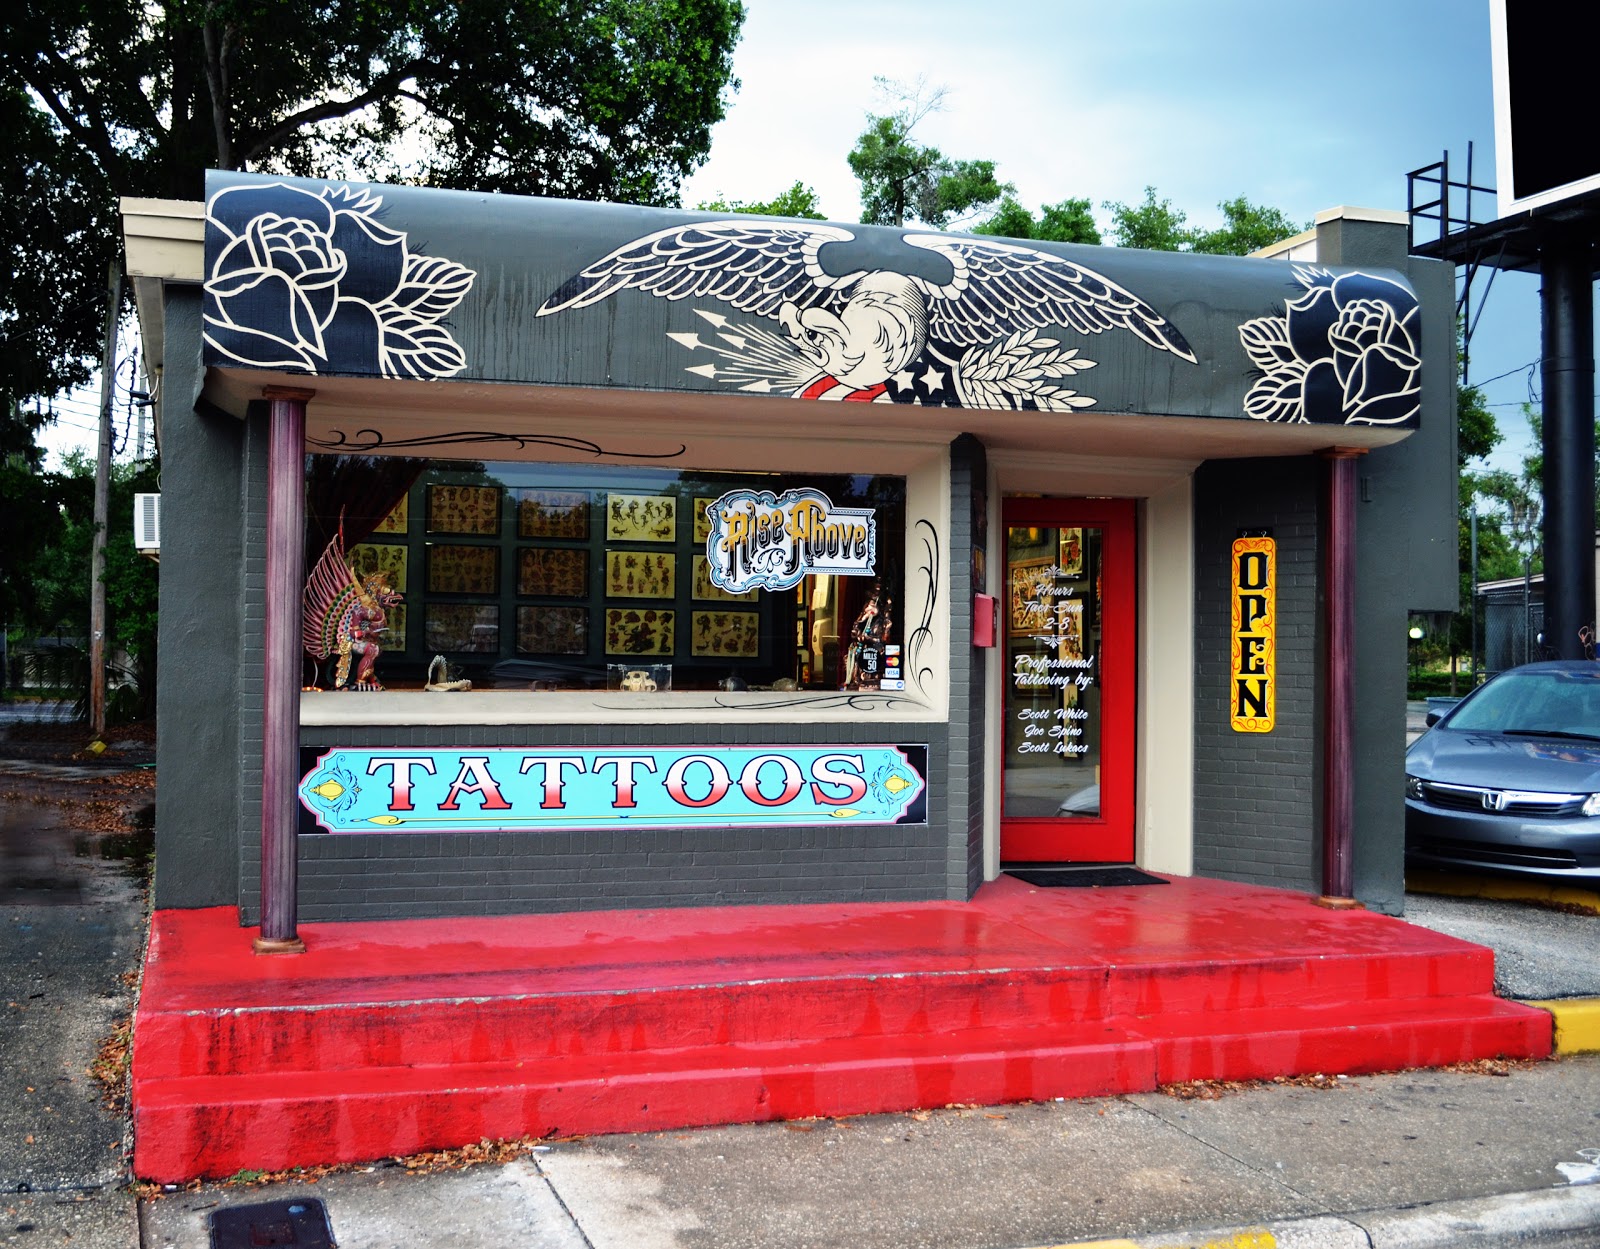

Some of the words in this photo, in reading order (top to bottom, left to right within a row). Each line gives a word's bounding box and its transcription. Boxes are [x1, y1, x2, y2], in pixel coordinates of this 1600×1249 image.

[721, 501, 784, 582] Rise
[785, 500, 867, 575] Above
[1035, 583, 1074, 596] Hours
[1043, 616, 1070, 630] 2-8
[1236, 551, 1269, 718] OPEN
[863, 652, 878, 660] MILLS
[867, 660, 877, 670] 50
[1014, 655, 1094, 672] Professional
[1013, 672, 1070, 690] Tattooing
[1075, 672, 1094, 691] by:
[1018, 708, 1050, 720] Scott
[1053, 708, 1089, 720] White
[1024, 724, 1044, 738] Joe
[1048, 725, 1082, 739] Spino
[1018, 741, 1050, 753] Scott
[1053, 741, 1089, 753] Lukacs
[365, 753, 868, 811] TATTOOS
